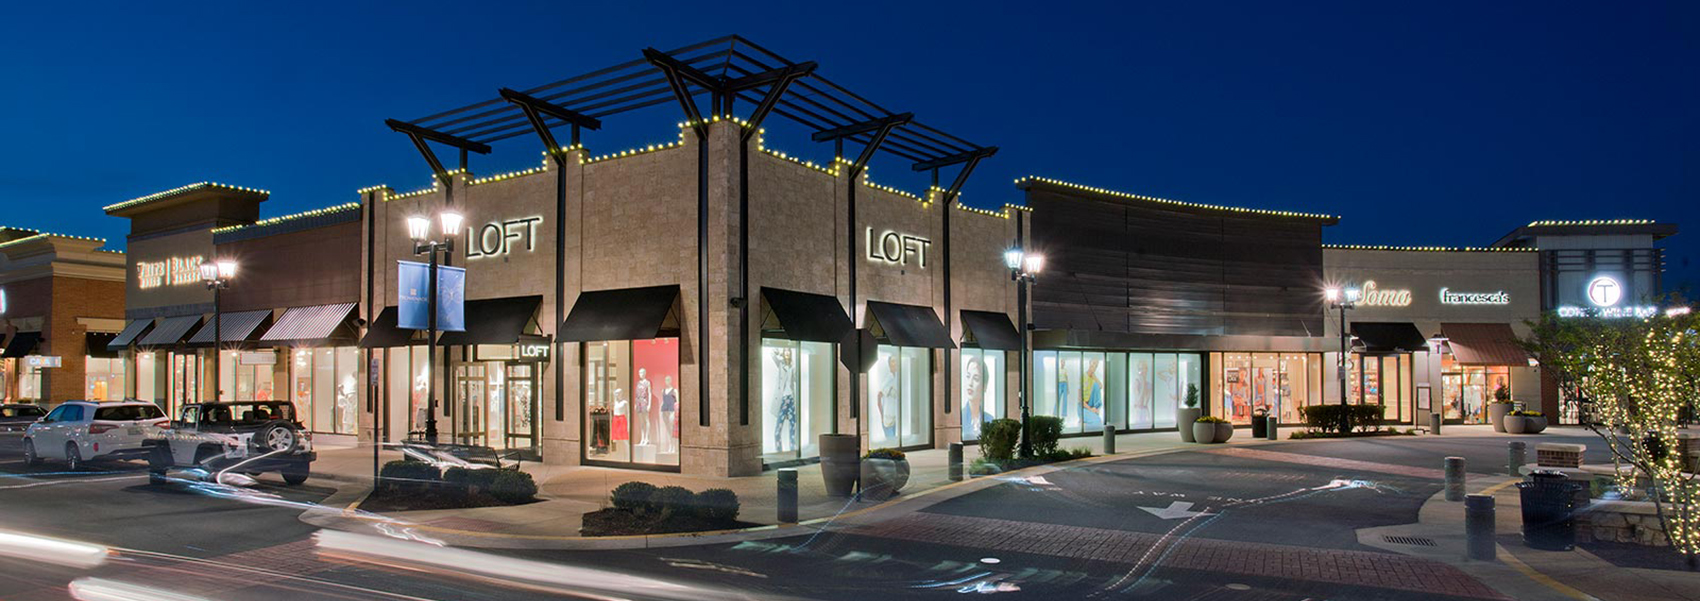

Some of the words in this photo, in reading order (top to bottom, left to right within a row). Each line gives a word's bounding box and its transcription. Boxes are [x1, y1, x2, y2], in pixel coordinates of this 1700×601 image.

[465, 216, 542, 259] LOFT
[867, 227, 931, 268] LOFT
[1355, 280, 1412, 306] Soma
[1439, 287, 1511, 305] francesca's
[521, 345, 549, 357] LOFT
